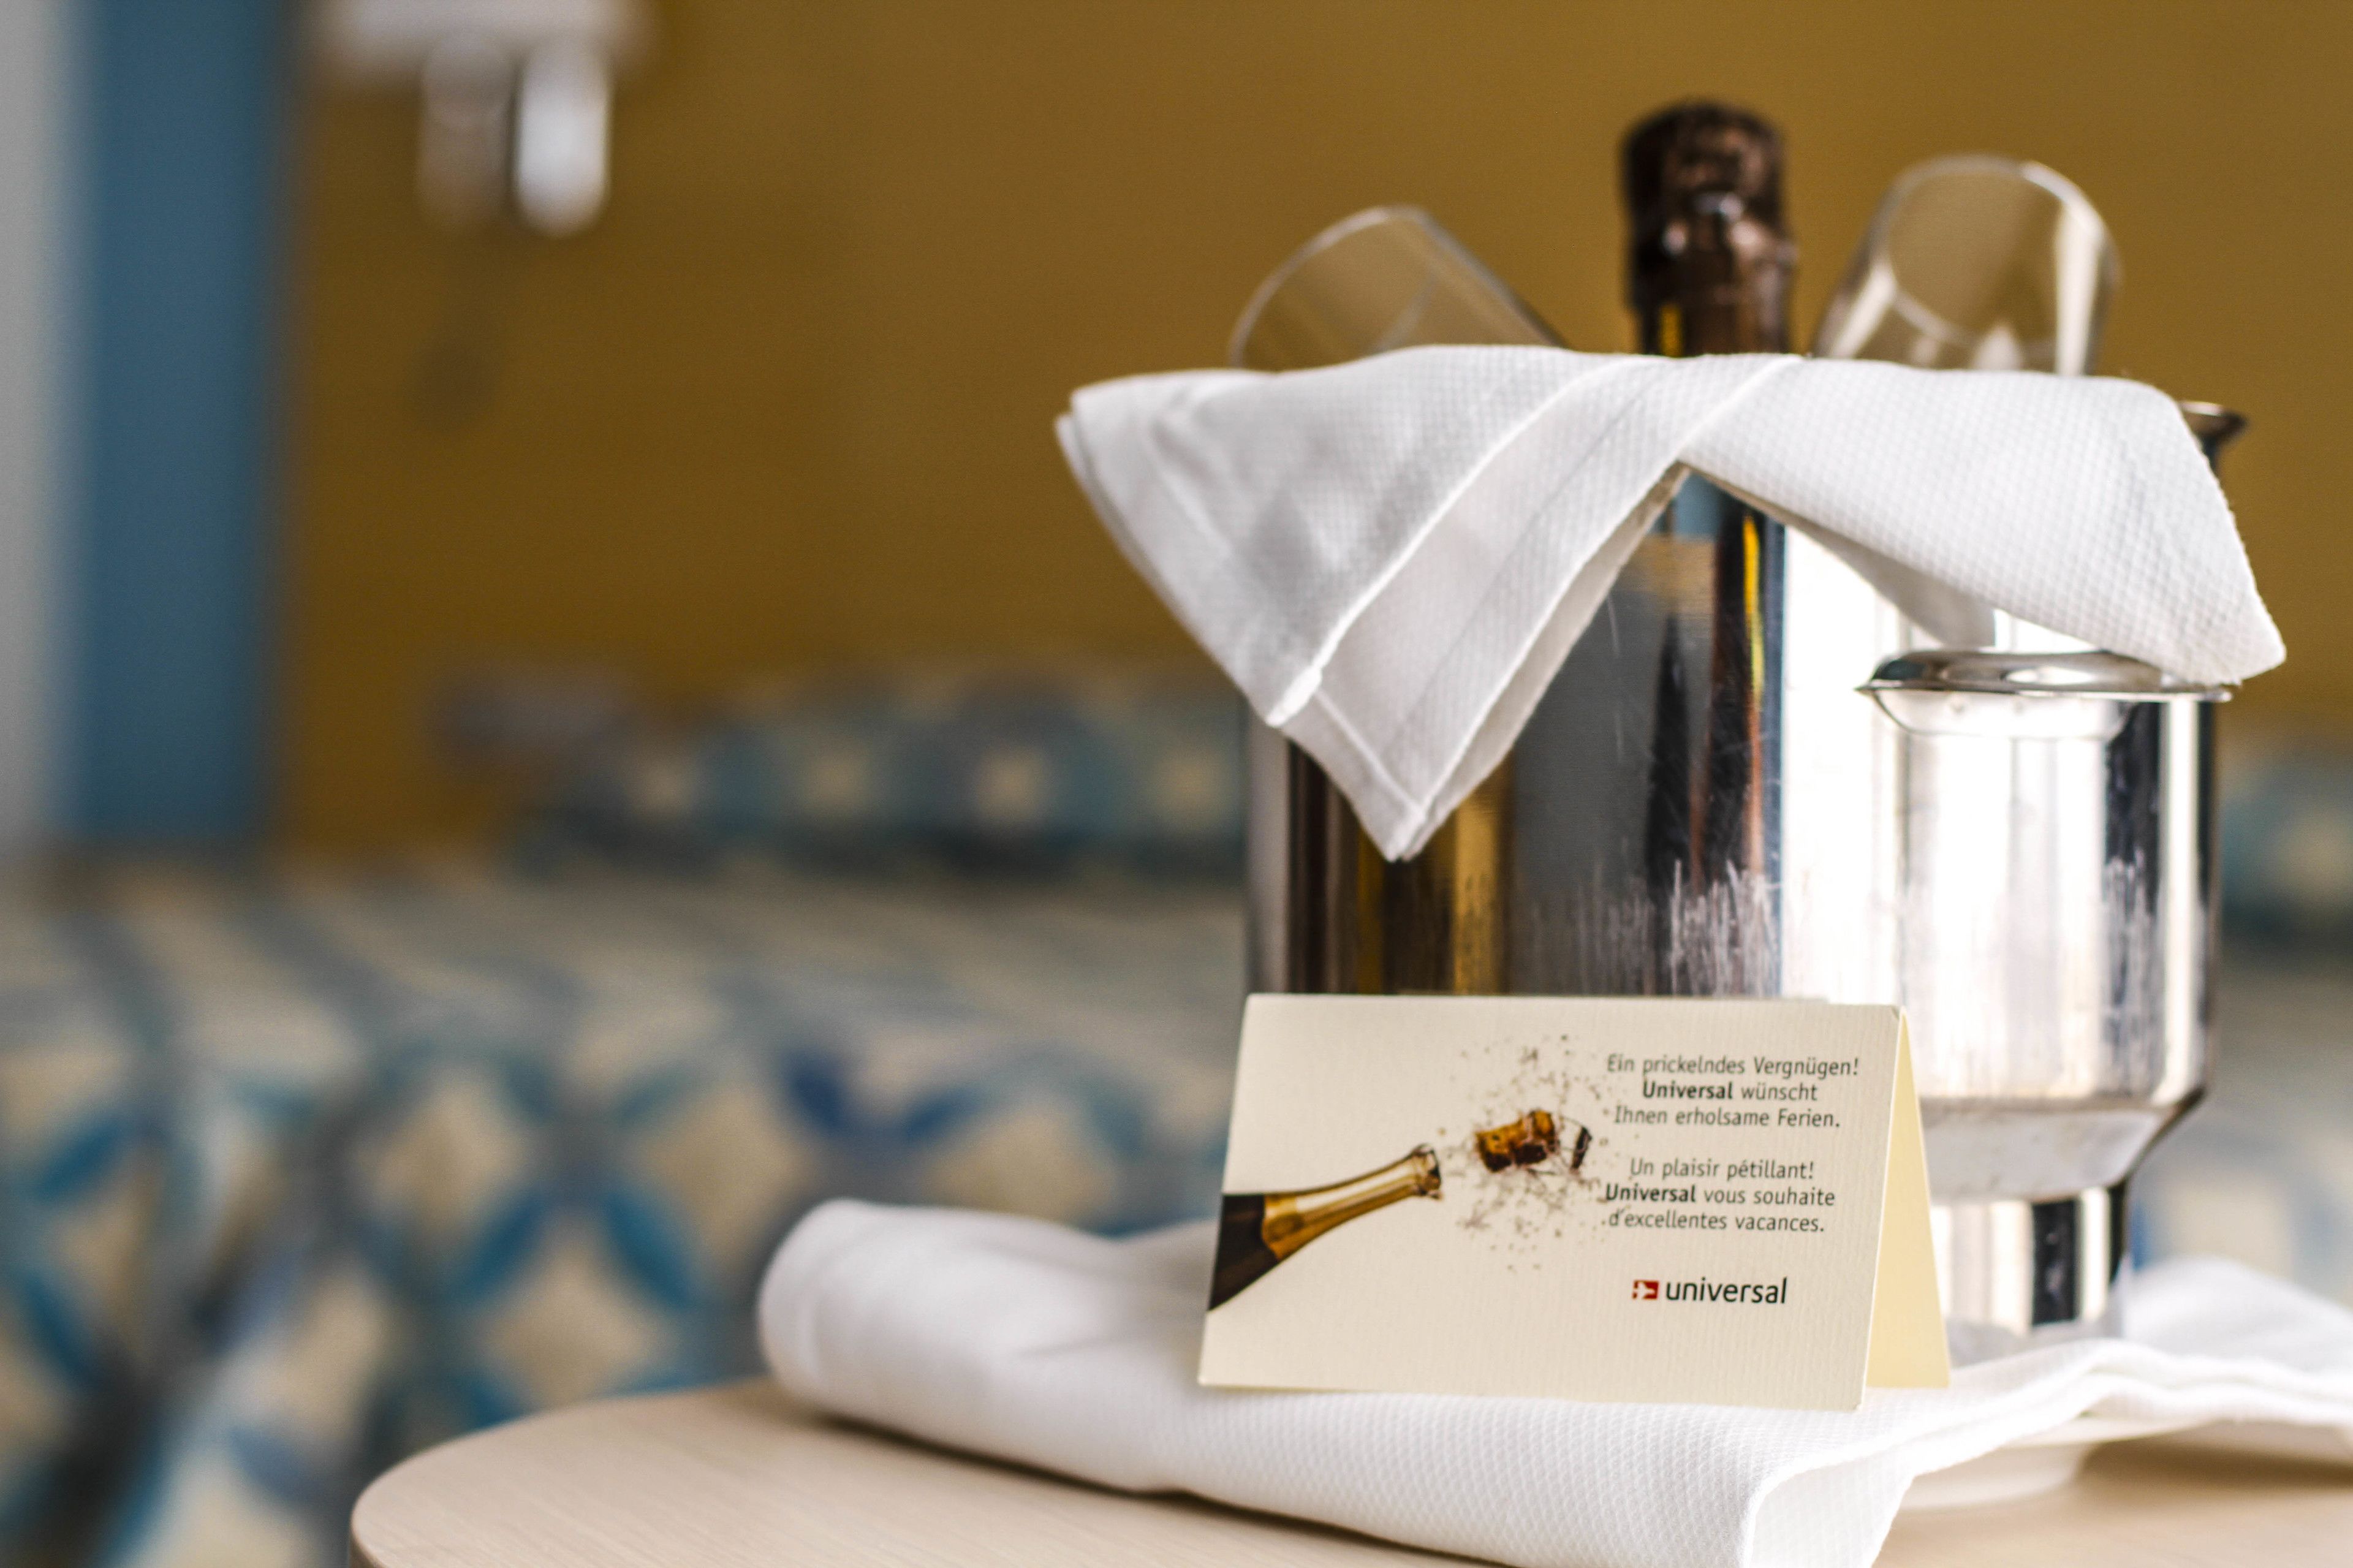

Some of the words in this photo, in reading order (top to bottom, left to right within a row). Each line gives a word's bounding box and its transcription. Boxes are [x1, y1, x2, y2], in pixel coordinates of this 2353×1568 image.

[1607, 1054, 1635, 1072] Ein
[1642, 1056, 1746, 1077] prickelndes
[1753, 1056, 1859, 1080] Vergnügen!
[1642, 1080, 1733, 1100] Universal
[1741, 1082, 1818, 1102] wünscht
[1613, 1105, 1667, 1124] Ihnen
[1675, 1107, 1770, 1126] erholsame
[1777, 1108, 1841, 1127] Ferien.
[1630, 1157, 1654, 1176] Un
[1662, 1157, 1720, 1180] plaisir
[1727, 1159, 1814, 1181] pétillant!
[1605, 1183, 1696, 1203] Universal
[1703, 1189, 1746, 1204] vous
[1753, 1187, 1836, 1206] souhaite
[1735, 1216, 1825, 1232] vacances.
[1665, 1276, 1787, 1305] universal
